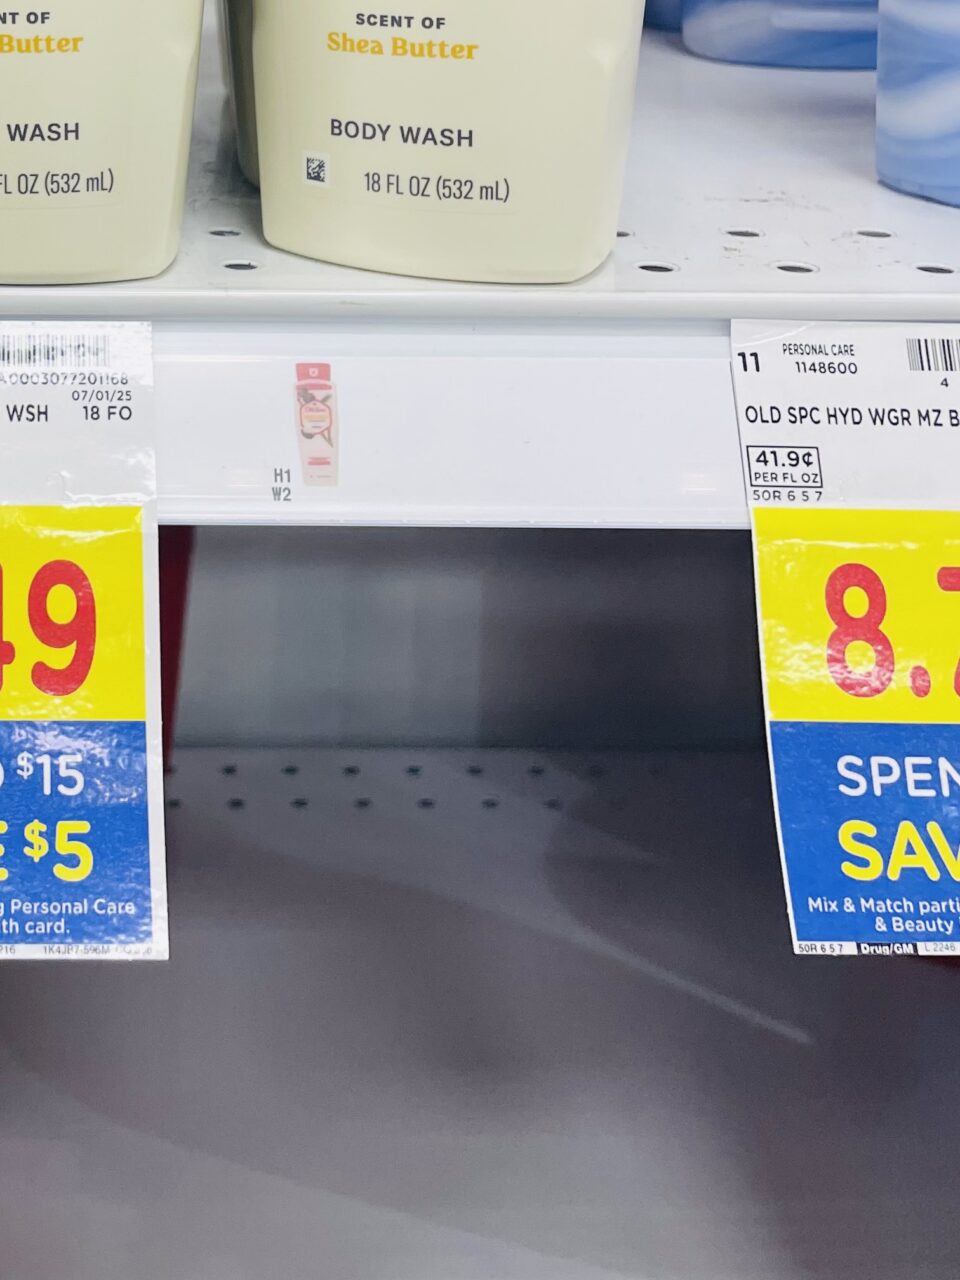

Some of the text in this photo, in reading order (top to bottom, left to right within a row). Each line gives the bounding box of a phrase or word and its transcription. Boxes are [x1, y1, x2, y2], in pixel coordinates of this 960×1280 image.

[26, 11, 51, 24] OF
[355, 13, 446, 30] SCENT OF
[327, 32, 480, 60] Shea Butter
[6, 122, 80, 141] WASH
[330, 119, 474, 148] BODY WASH
[17, 174, 39, 194] OZ
[44, 172, 81, 196] (532
[86, 168, 115, 192] mL)
[364, 172, 510, 203] 18 FL OZ (532 mL)
[783, 344, 855, 356] PERSONAL CARE
[738, 352, 760, 372] 11
[795, 362, 858, 375] 1148600
[72, 390, 132, 403] 07/01/25
[6, 404, 48, 422] WSH
[83, 405, 100, 421] 18
[108, 405, 132, 421] FO
[745, 406, 943, 427] OLD SPC HYD WGR MZ
[756, 450, 814, 467] 41.9¢
[273, 468, 291, 483] H1
[754, 472, 819, 483] PER FL OZ
[272, 487, 291, 501] W2
[17, 751, 85, 796] $15
[23, 819, 94, 882] $5
[11, 898, 88, 914] Personal
[94, 898, 135, 914] Care
[808, 896, 914, 913] Mix & Match
[25, 918, 70, 934] card.
[892, 916, 953, 935] Beauty
[861, 944, 914, 955] Drug/GM
